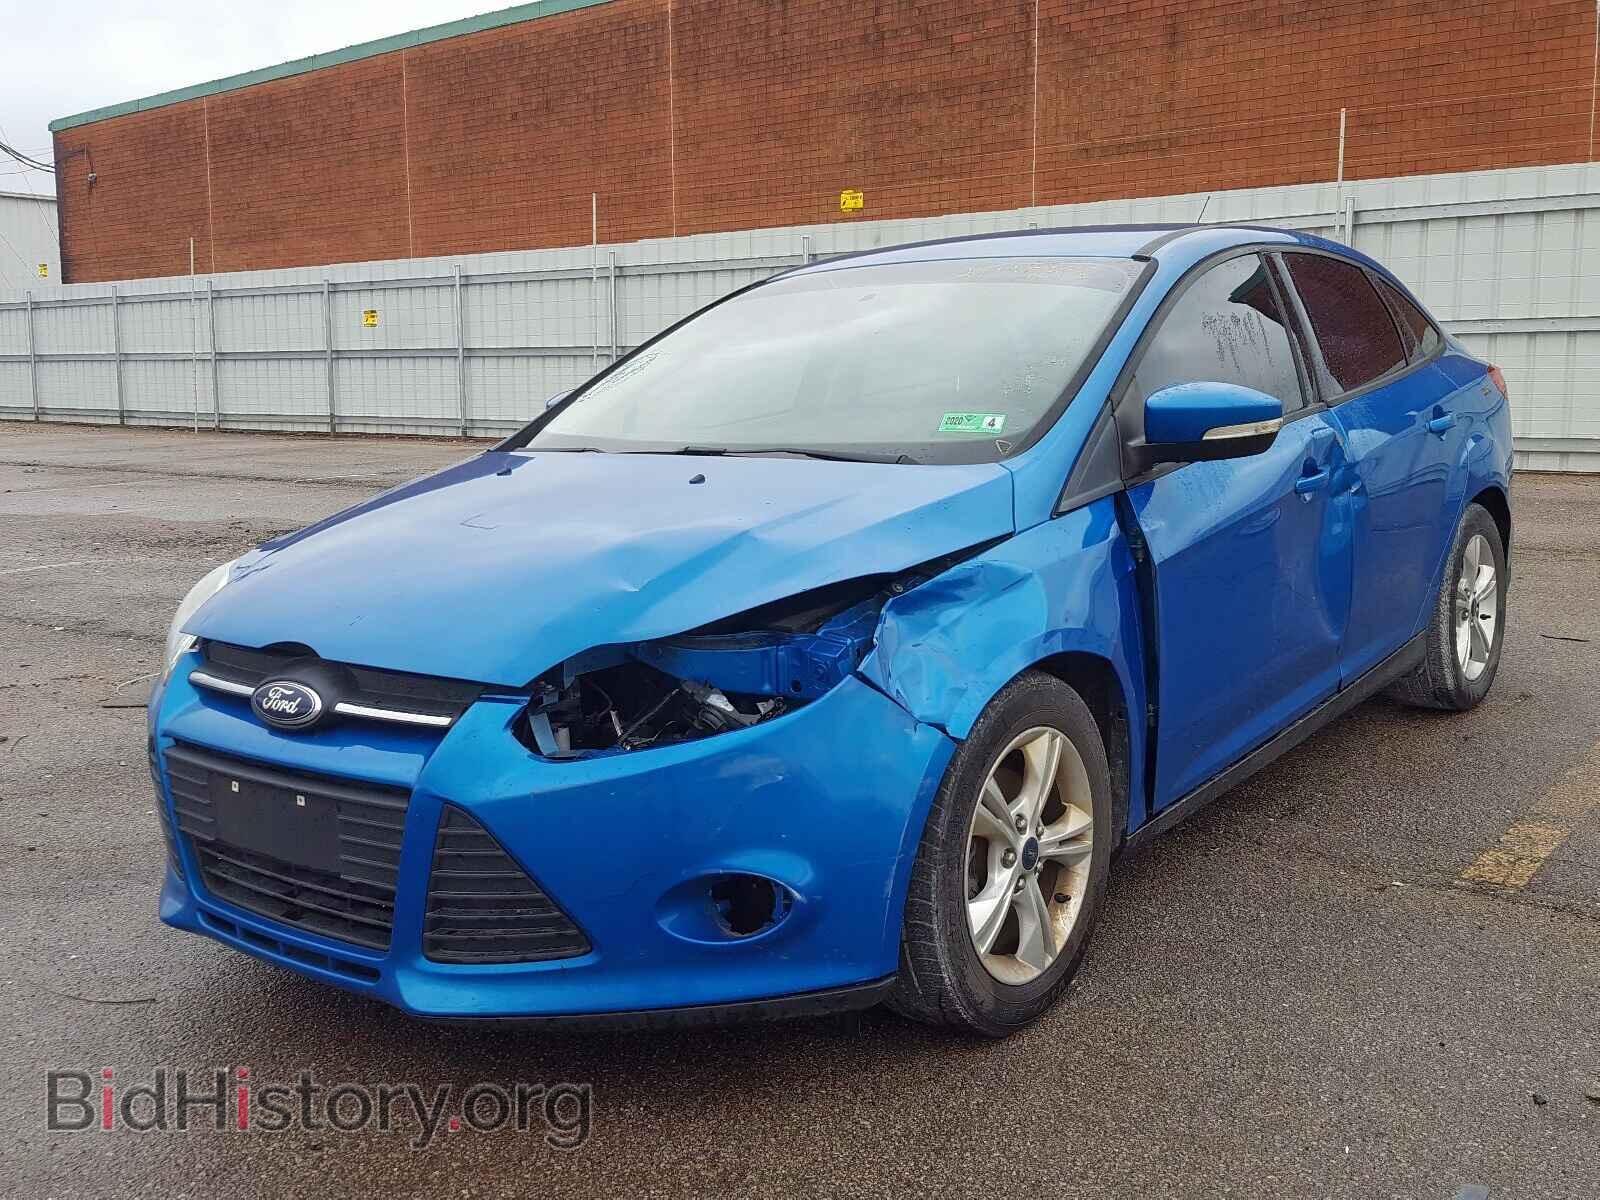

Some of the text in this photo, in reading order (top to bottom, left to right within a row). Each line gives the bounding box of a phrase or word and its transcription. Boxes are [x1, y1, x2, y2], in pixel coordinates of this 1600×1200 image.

[945, 416, 964, 426] 2020
[988, 417, 997, 428] 4
[263, 686, 302, 714] Ford
